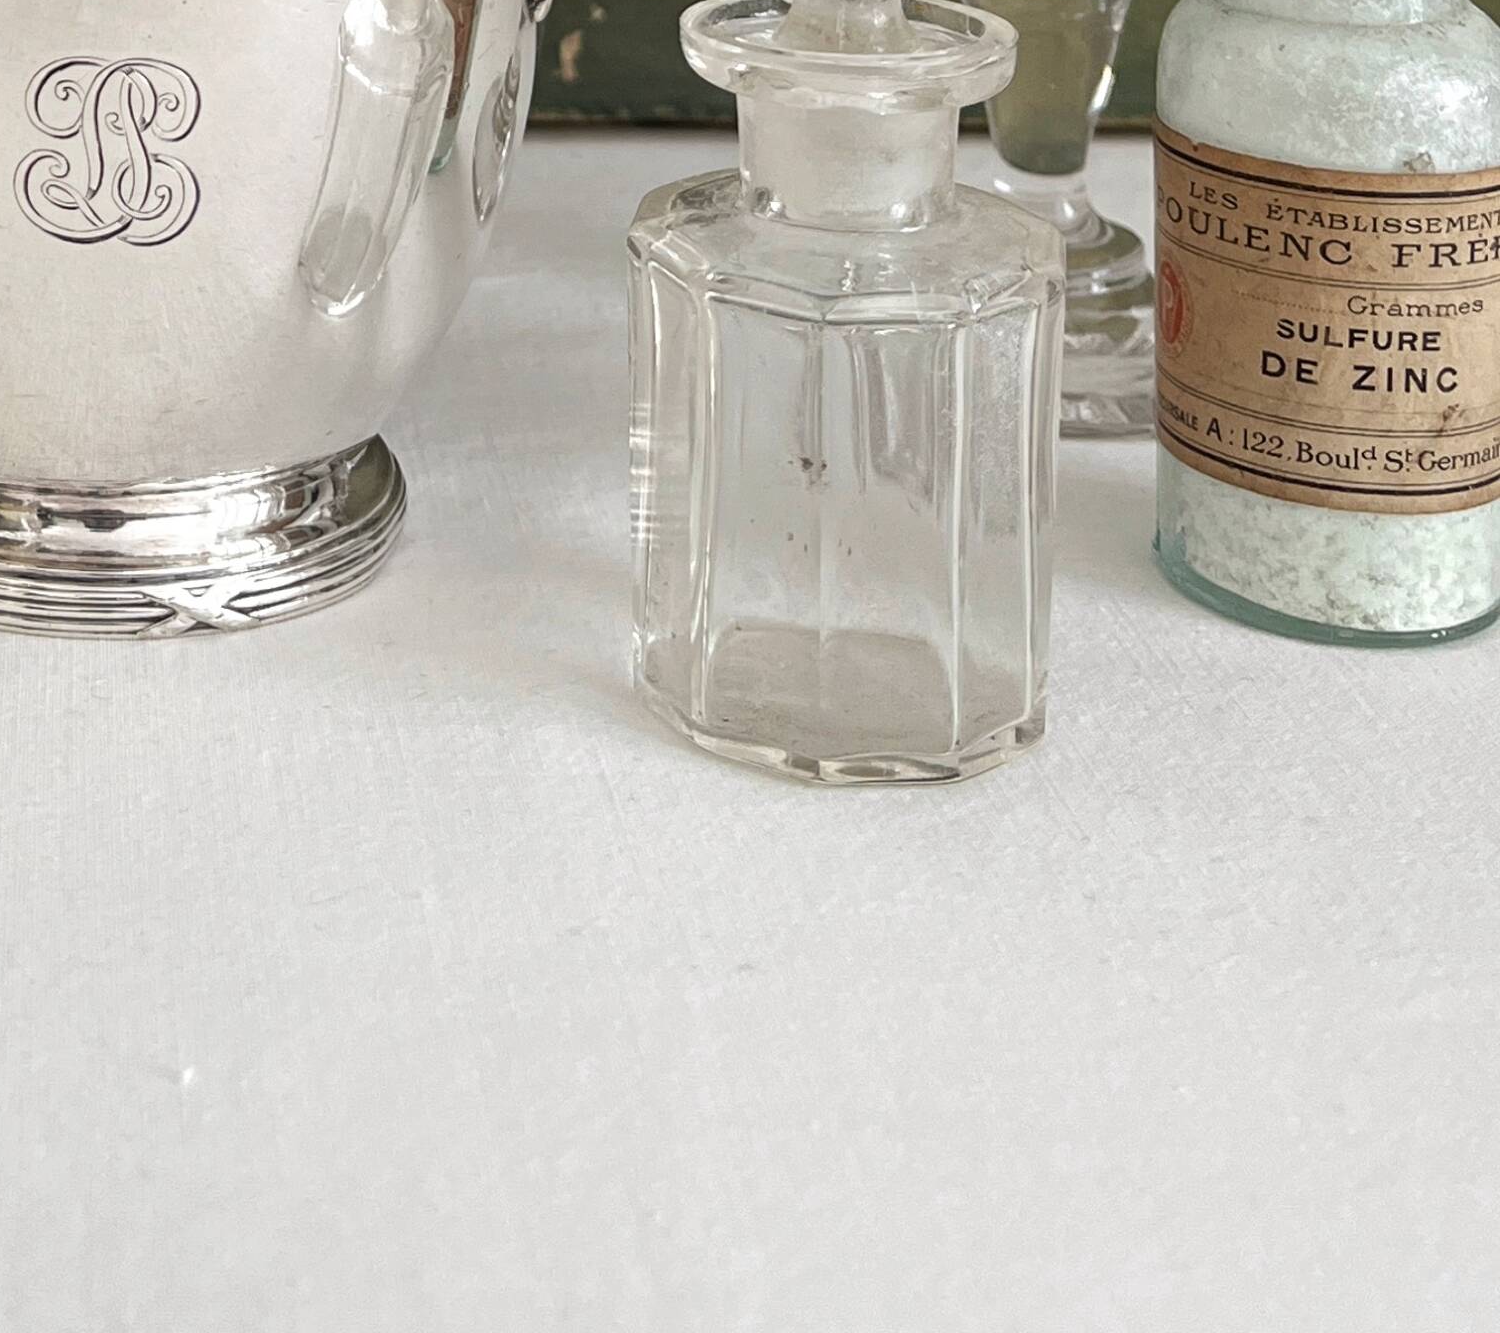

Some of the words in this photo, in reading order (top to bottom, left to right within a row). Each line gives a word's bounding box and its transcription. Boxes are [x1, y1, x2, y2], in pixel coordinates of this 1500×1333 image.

[1188, 180, 1239, 211] LES
[1346, 294, 1484, 318] Grammes
[1275, 318, 1442, 353] SULFURE
[1261, 349, 1319, 386] DE
[1351, 365, 1459, 394] ZINC
